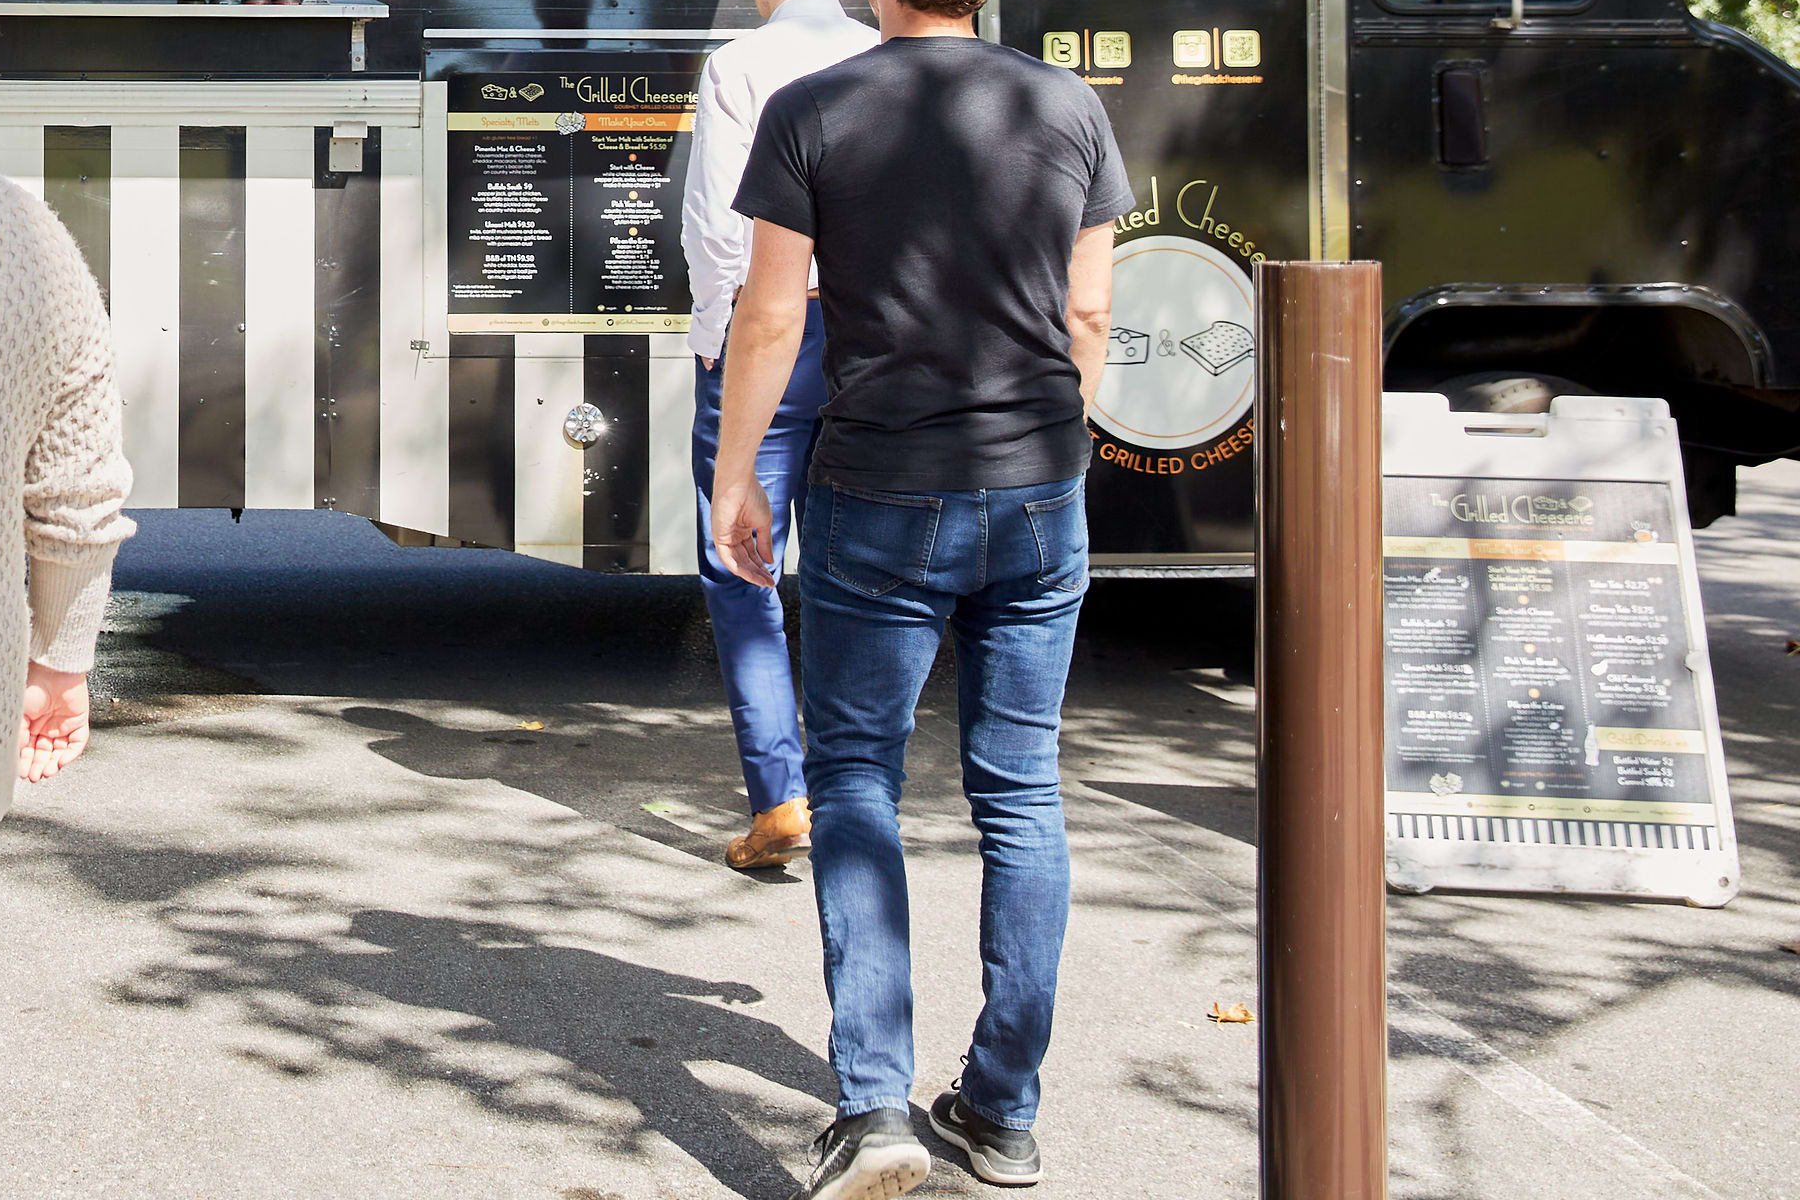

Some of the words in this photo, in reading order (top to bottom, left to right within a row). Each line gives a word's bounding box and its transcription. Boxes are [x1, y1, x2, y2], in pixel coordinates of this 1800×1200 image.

[560, 77, 574, 88] The
[577, 77, 625, 103] Grilled
[630, 77, 698, 103] Cheeserie
[482, 116, 515, 128] Specialty
[516, 117, 539, 126] Melts
[599, 117, 623, 127] Make
[1100, 443, 1184, 475] GRILLED
[1450, 494, 1508, 524] Grilled
[1511, 495, 1594, 525] Cheeserie
